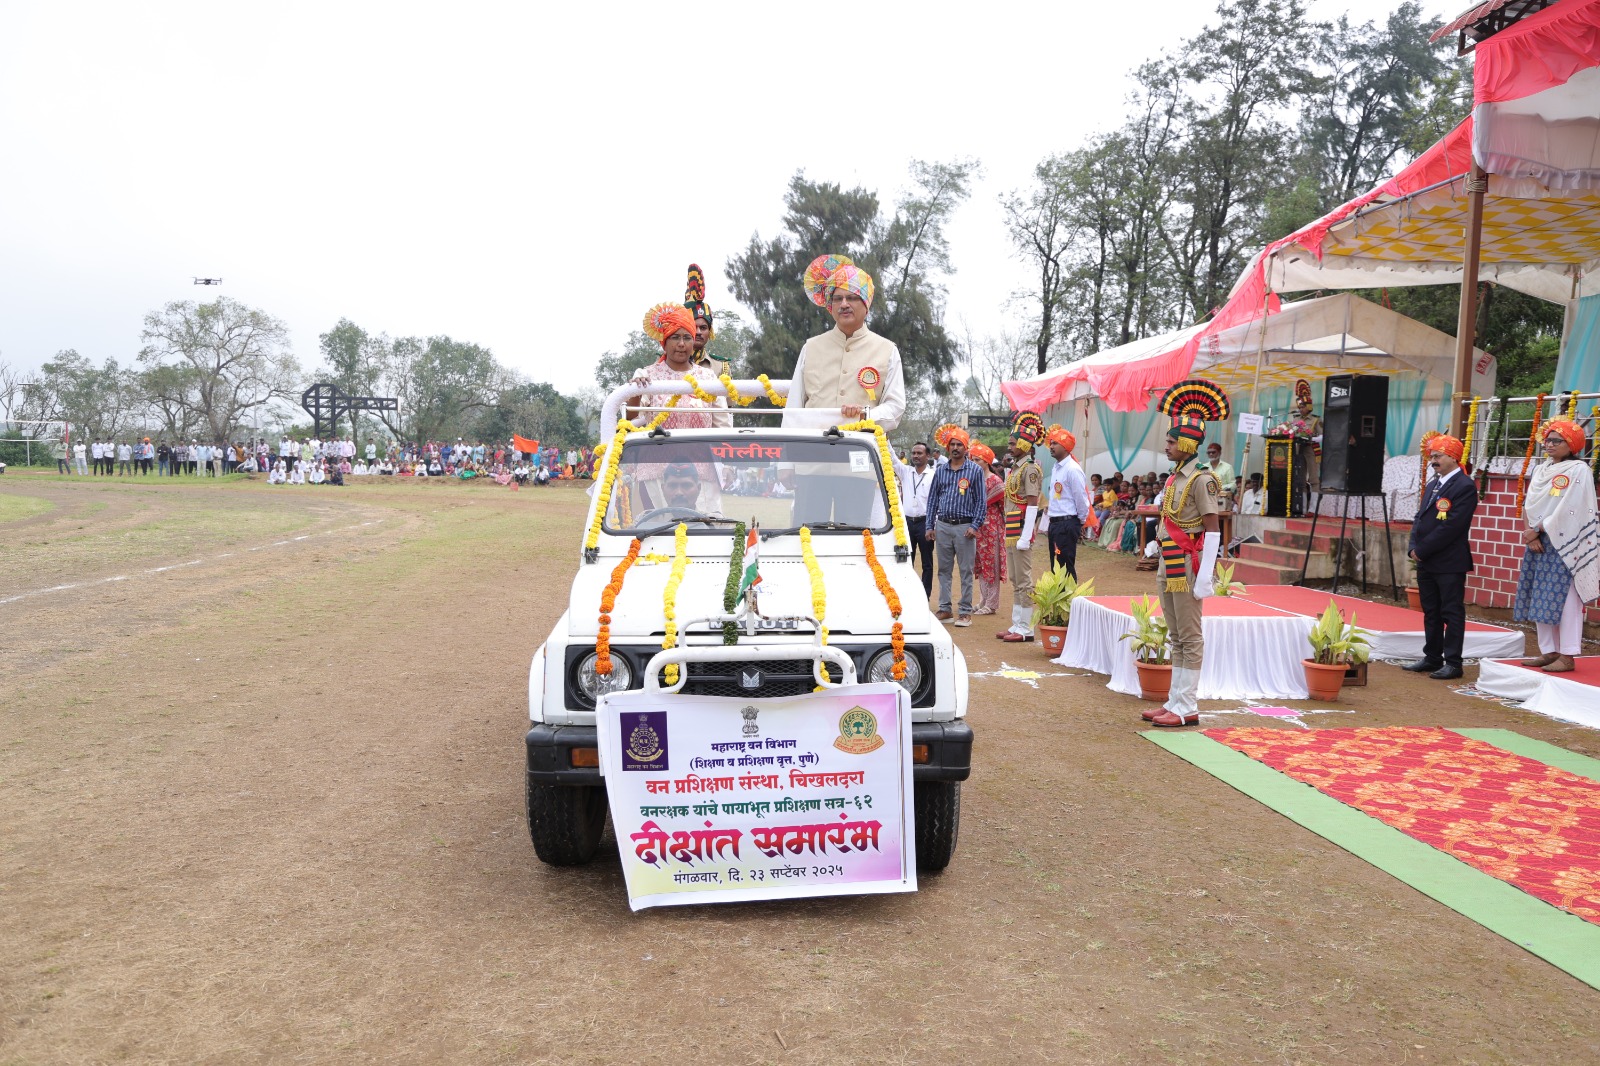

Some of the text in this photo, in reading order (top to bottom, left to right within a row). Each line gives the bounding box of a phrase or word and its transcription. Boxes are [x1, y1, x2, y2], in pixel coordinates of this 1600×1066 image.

[711, 442, 782, 459] पोलीस
[711, 737, 797, 754] महाराष्ट्र वन विभाग
[690, 757, 725, 771] (शिक्षण
[727, 758, 735, 767] व
[737, 754, 774, 768] प्रशिक्षण
[798, 751, 820, 768] पुणे)
[646, 770, 865, 795] वन प्रशिक्षण संस्था, चिखलदरा
[640, 804, 689, 819] वनरक्षक
[693, 800, 718, 816] यांचे
[722, 801, 770, 819] पायाभूत
[774, 796, 821, 814] प्रशिक्षण
[630, 812, 883, 869] दीक्षांत समारंभ
[674, 864, 844, 885] मंगळवार, दि. २३ सप्टेंबर २०२५
